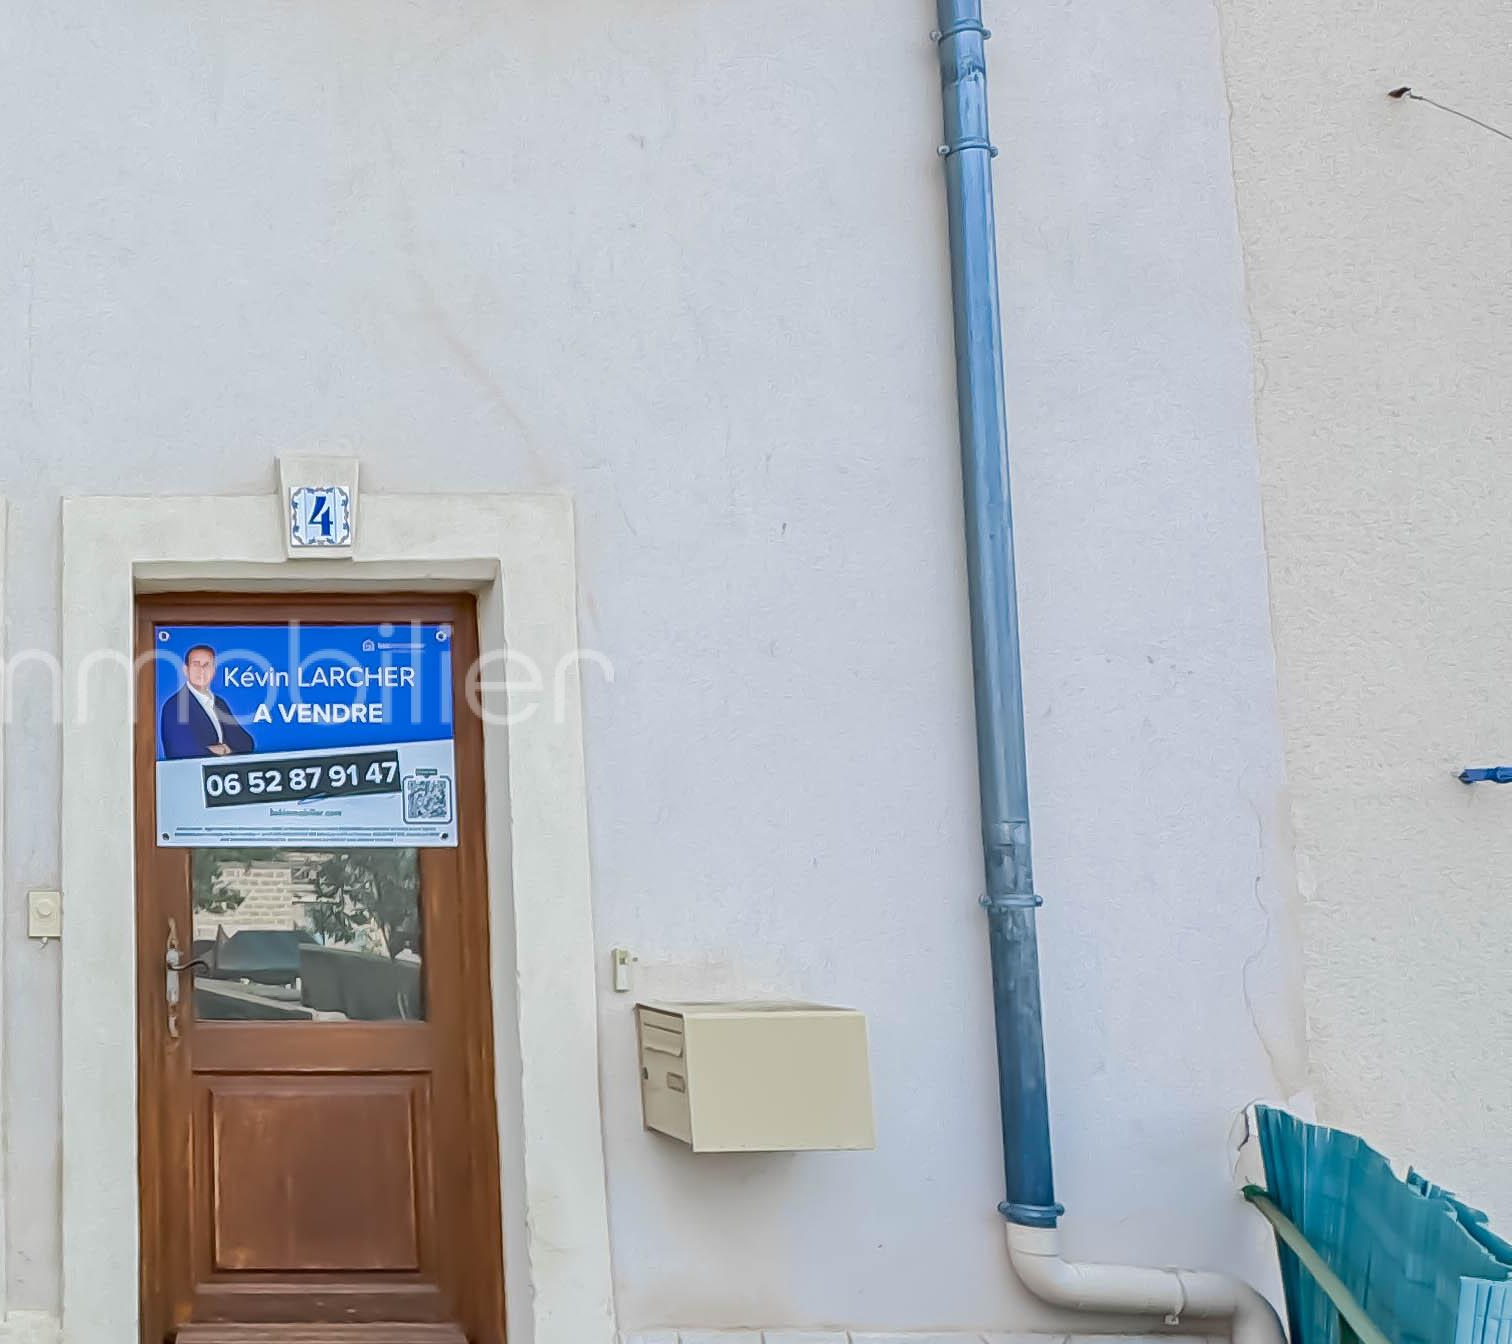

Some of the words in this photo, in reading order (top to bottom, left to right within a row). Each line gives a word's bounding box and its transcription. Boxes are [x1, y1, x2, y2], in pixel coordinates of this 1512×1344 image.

[307, 495, 334, 537] 4
[223, 665, 289, 688] Kévin
[297, 666, 416, 688] LARCHER
[252, 703, 273, 724] A
[277, 703, 384, 724] VENDRE
[205, 773, 242, 797] 06
[247, 770, 283, 794] 52
[288, 767, 322, 791] 87
[328, 764, 359, 788] 91
[365, 761, 398, 784] 47
